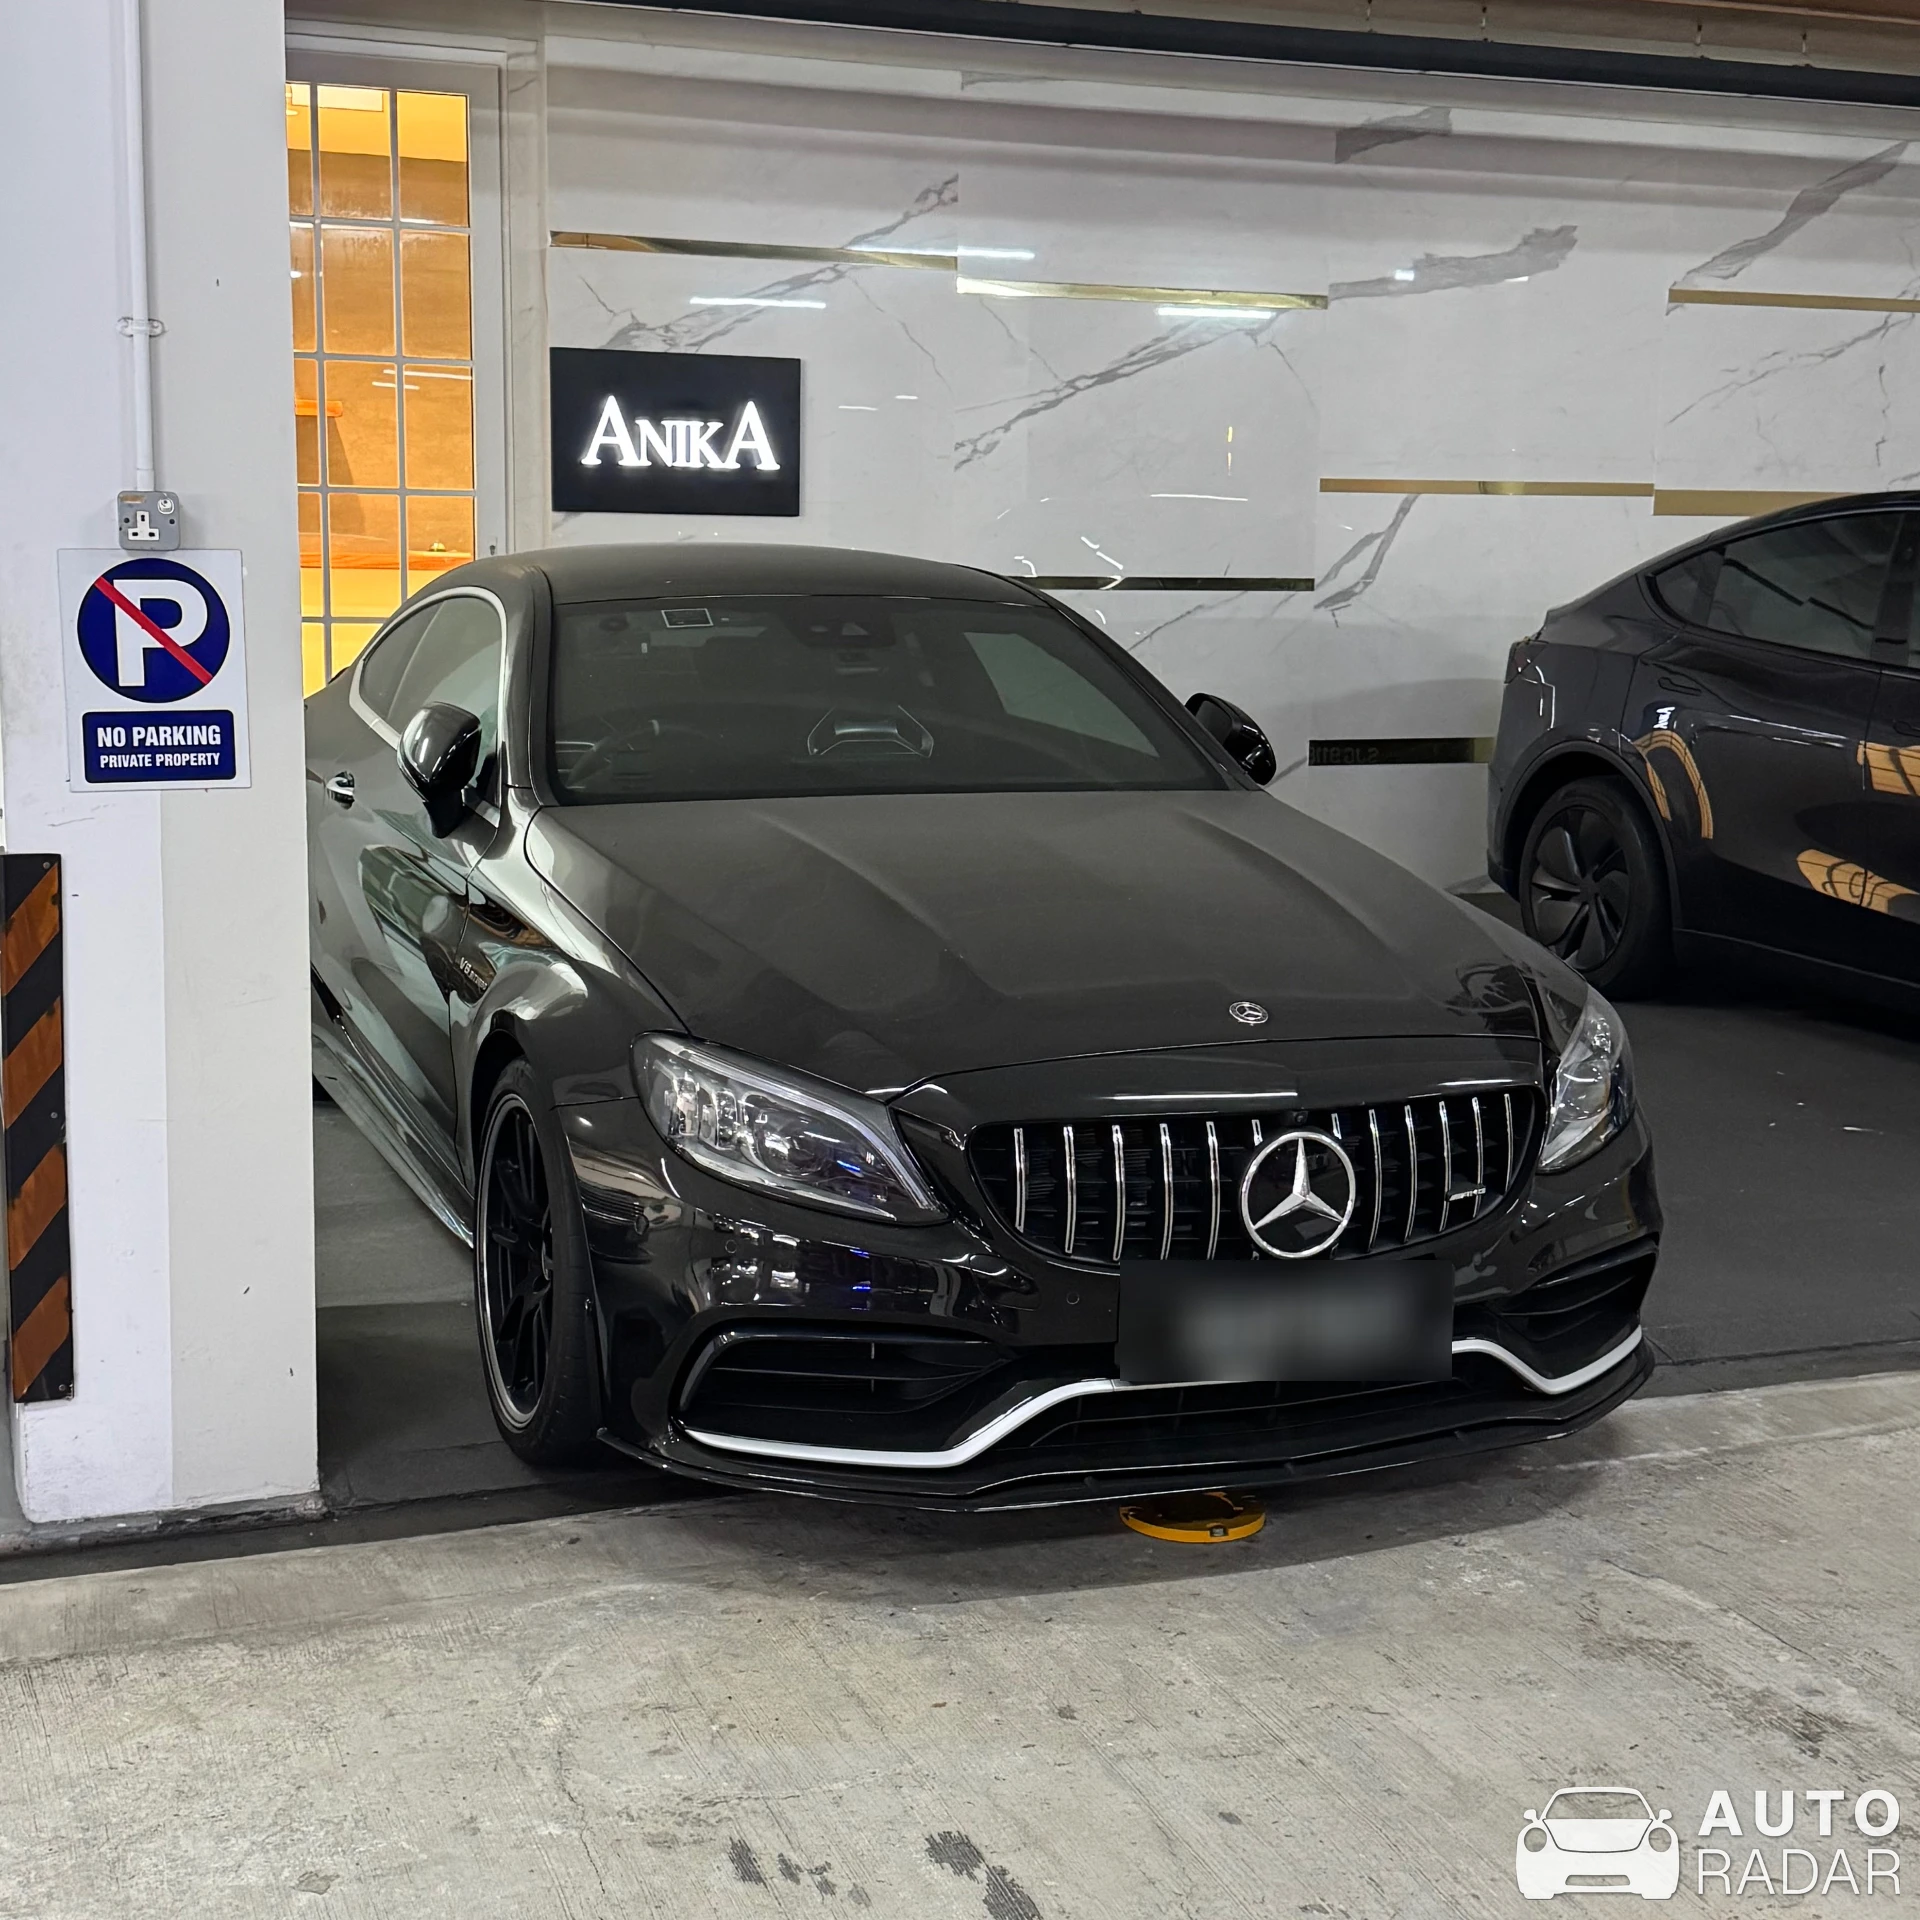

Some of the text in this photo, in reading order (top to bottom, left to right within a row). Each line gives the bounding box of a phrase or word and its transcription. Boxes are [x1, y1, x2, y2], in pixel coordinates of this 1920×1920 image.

[580, 395, 781, 471] ANIKA
[112, 578, 208, 687] P
[97, 724, 222, 748] NO PARKING
[99, 752, 221, 768] PRIVATE PROPERTY
